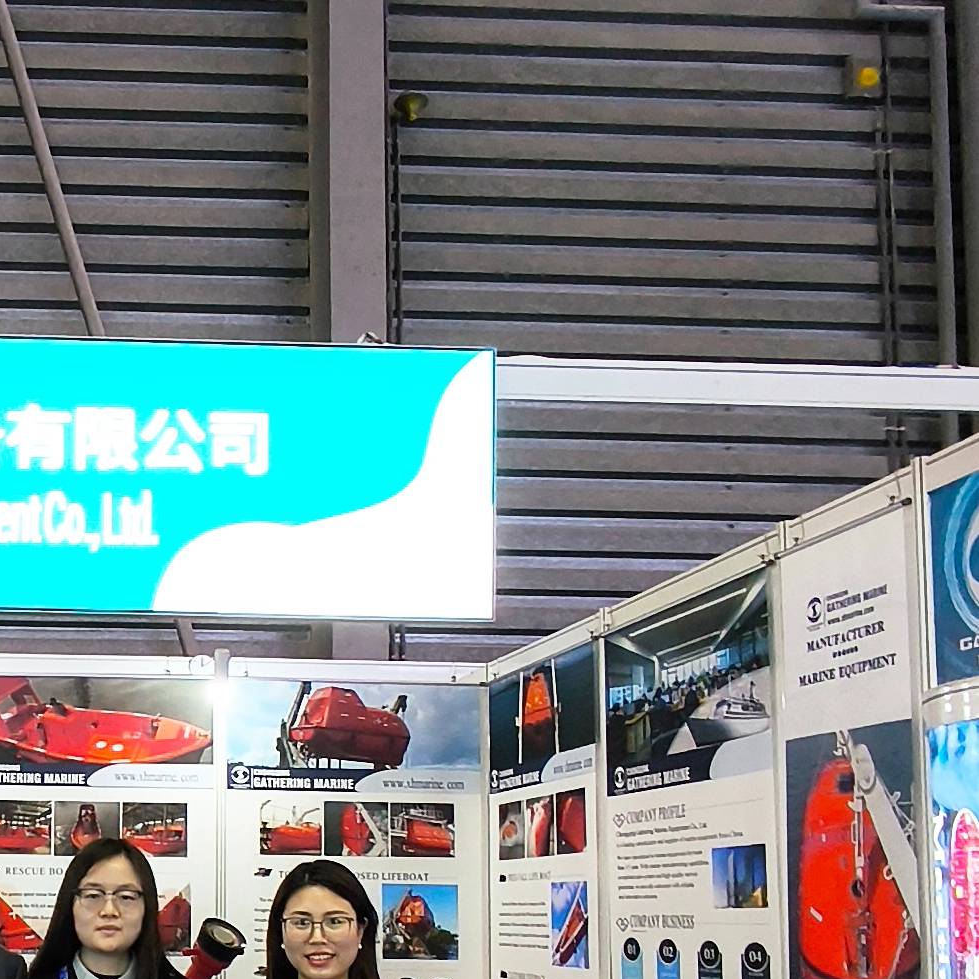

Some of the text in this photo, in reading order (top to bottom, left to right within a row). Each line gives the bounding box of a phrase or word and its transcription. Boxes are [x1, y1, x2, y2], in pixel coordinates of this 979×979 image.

[101, 489, 160, 547] Ltd.
[807, 620, 885, 652] MANUFACTURER
[799, 653, 897, 687] MARINE EQUIPMENT
[44, 773, 86, 785] MARINE
[253, 777, 354, 790] GATHERING MARINE
[5, 867, 63, 875] RESCUE BO
[381, 872, 429, 882] LIFEBOAT
[748, 951, 762, 962] 04
